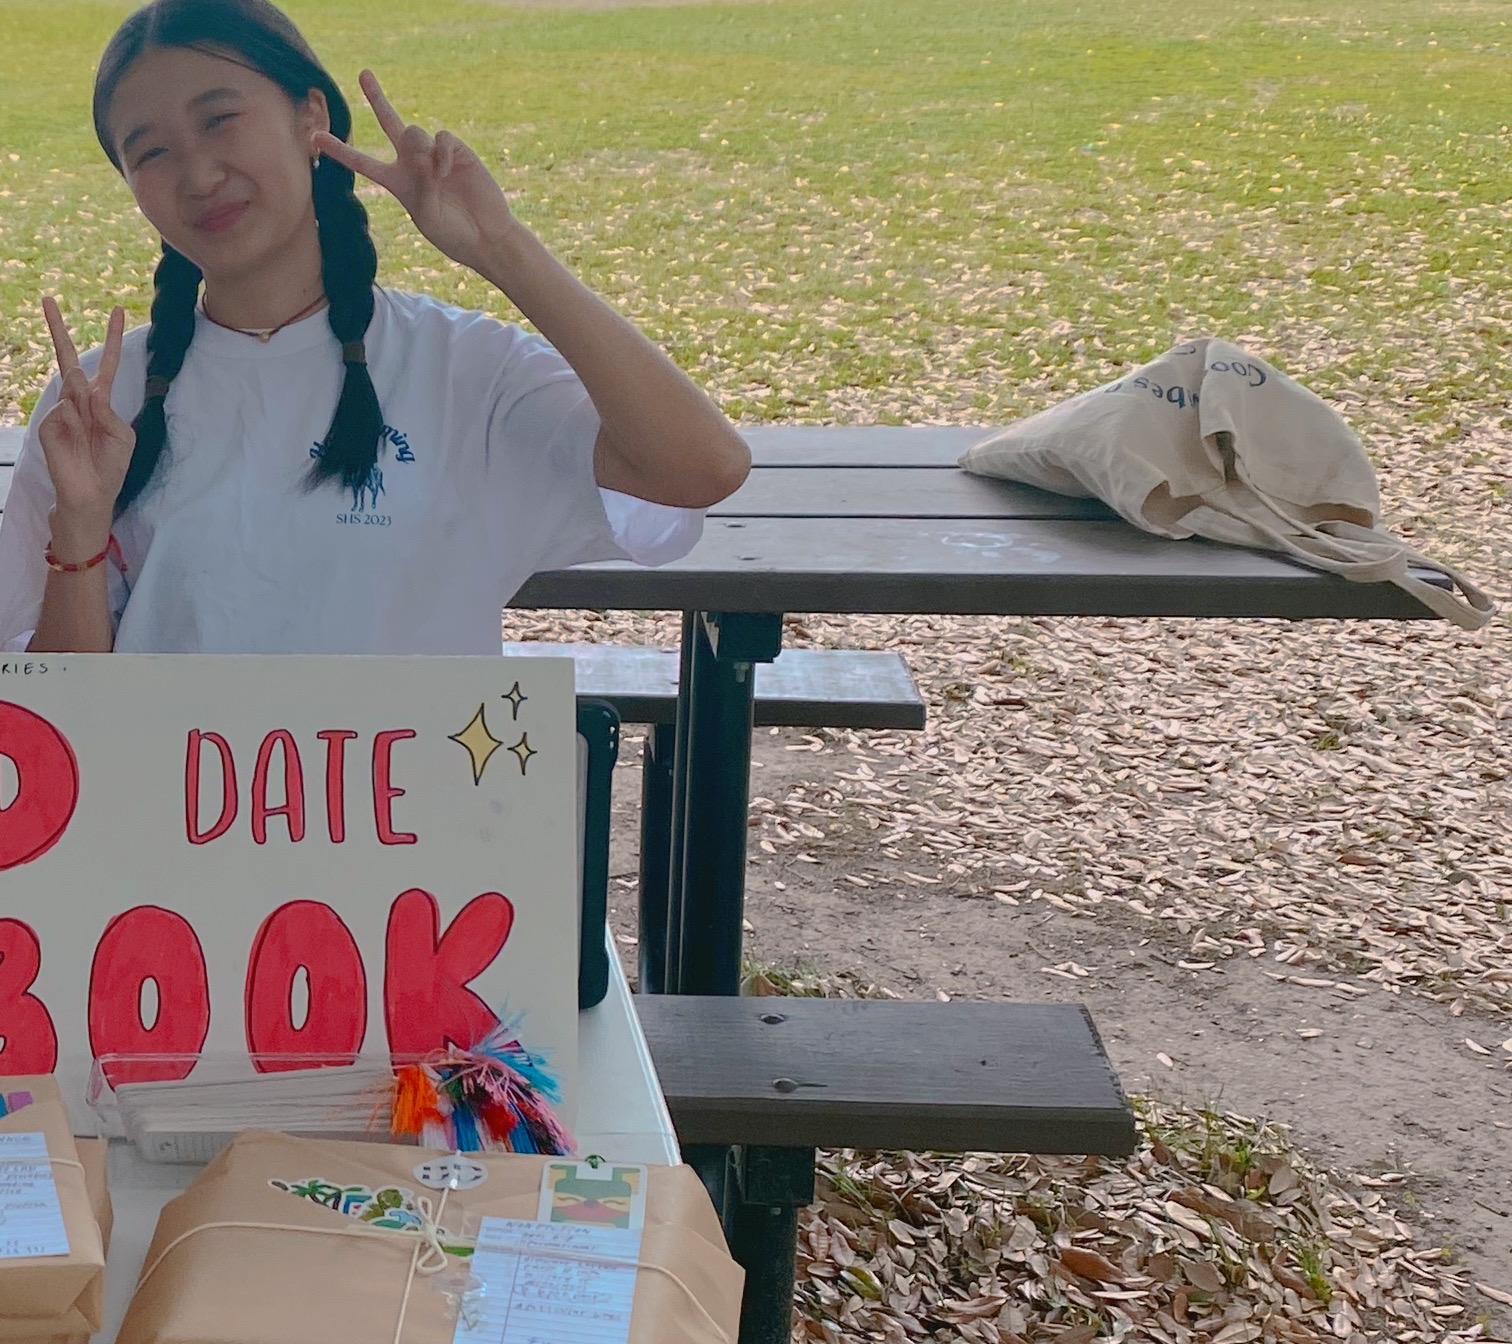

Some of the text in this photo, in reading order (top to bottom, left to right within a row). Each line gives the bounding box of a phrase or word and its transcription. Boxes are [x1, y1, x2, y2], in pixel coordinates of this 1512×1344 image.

[336, 514, 392, 527] SHS 2023
[185, 728, 418, 845] DATE
